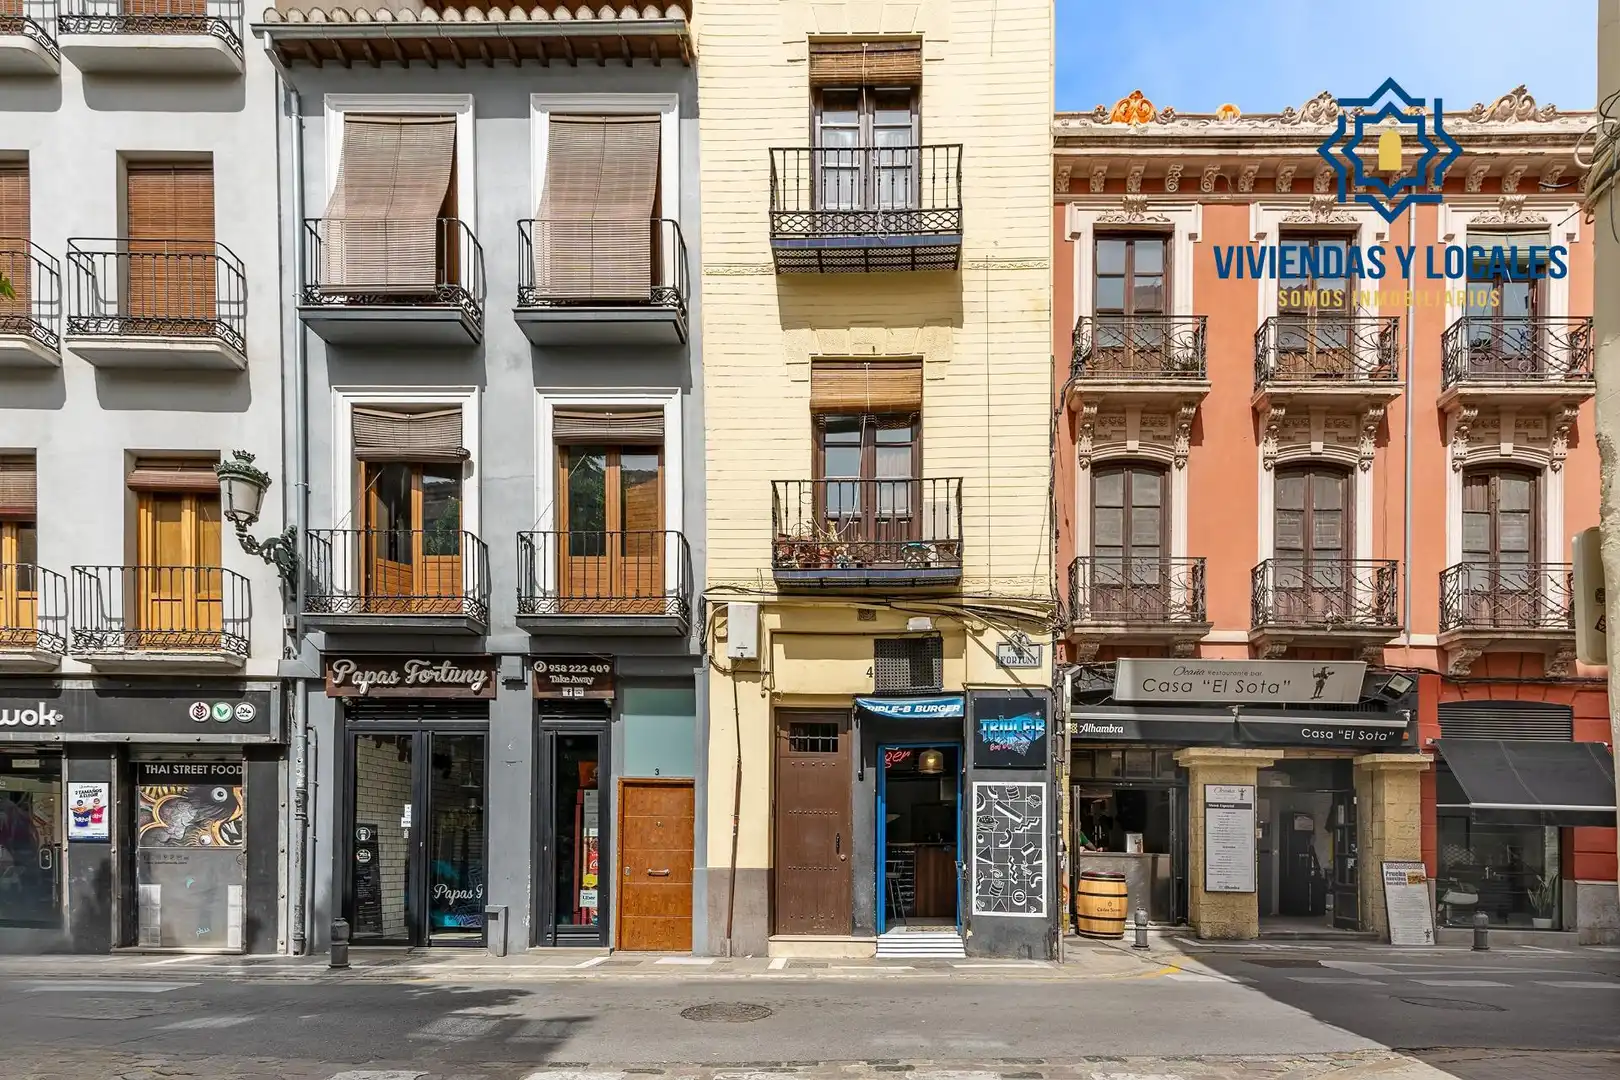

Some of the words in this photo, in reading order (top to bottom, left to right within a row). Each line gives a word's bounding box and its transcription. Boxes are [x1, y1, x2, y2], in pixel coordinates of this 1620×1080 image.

[549, 664, 568, 673] 958
[568, 664, 588, 673] 222
[589, 664, 610, 673] 409
[866, 666, 874, 678] 4
[1173, 665, 1205, 677] Ocaña
[332, 659, 400, 694] Papas
[404, 659, 488, 691] Fortuny
[549, 674, 570, 684] Take
[570, 675, 595, 686] Away
[1142, 678, 1193, 693] Casa
[914, 704, 961, 713] BURGER
[1079, 722, 1124, 734] Alhambra
[1301, 728, 1334, 739] Casa
[144, 764, 170, 775] THAI
[173, 764, 208, 775] STREET
[211, 764, 243, 775] FOOD
[654, 767, 660, 776] 3
[433, 883, 474, 906] Papas
